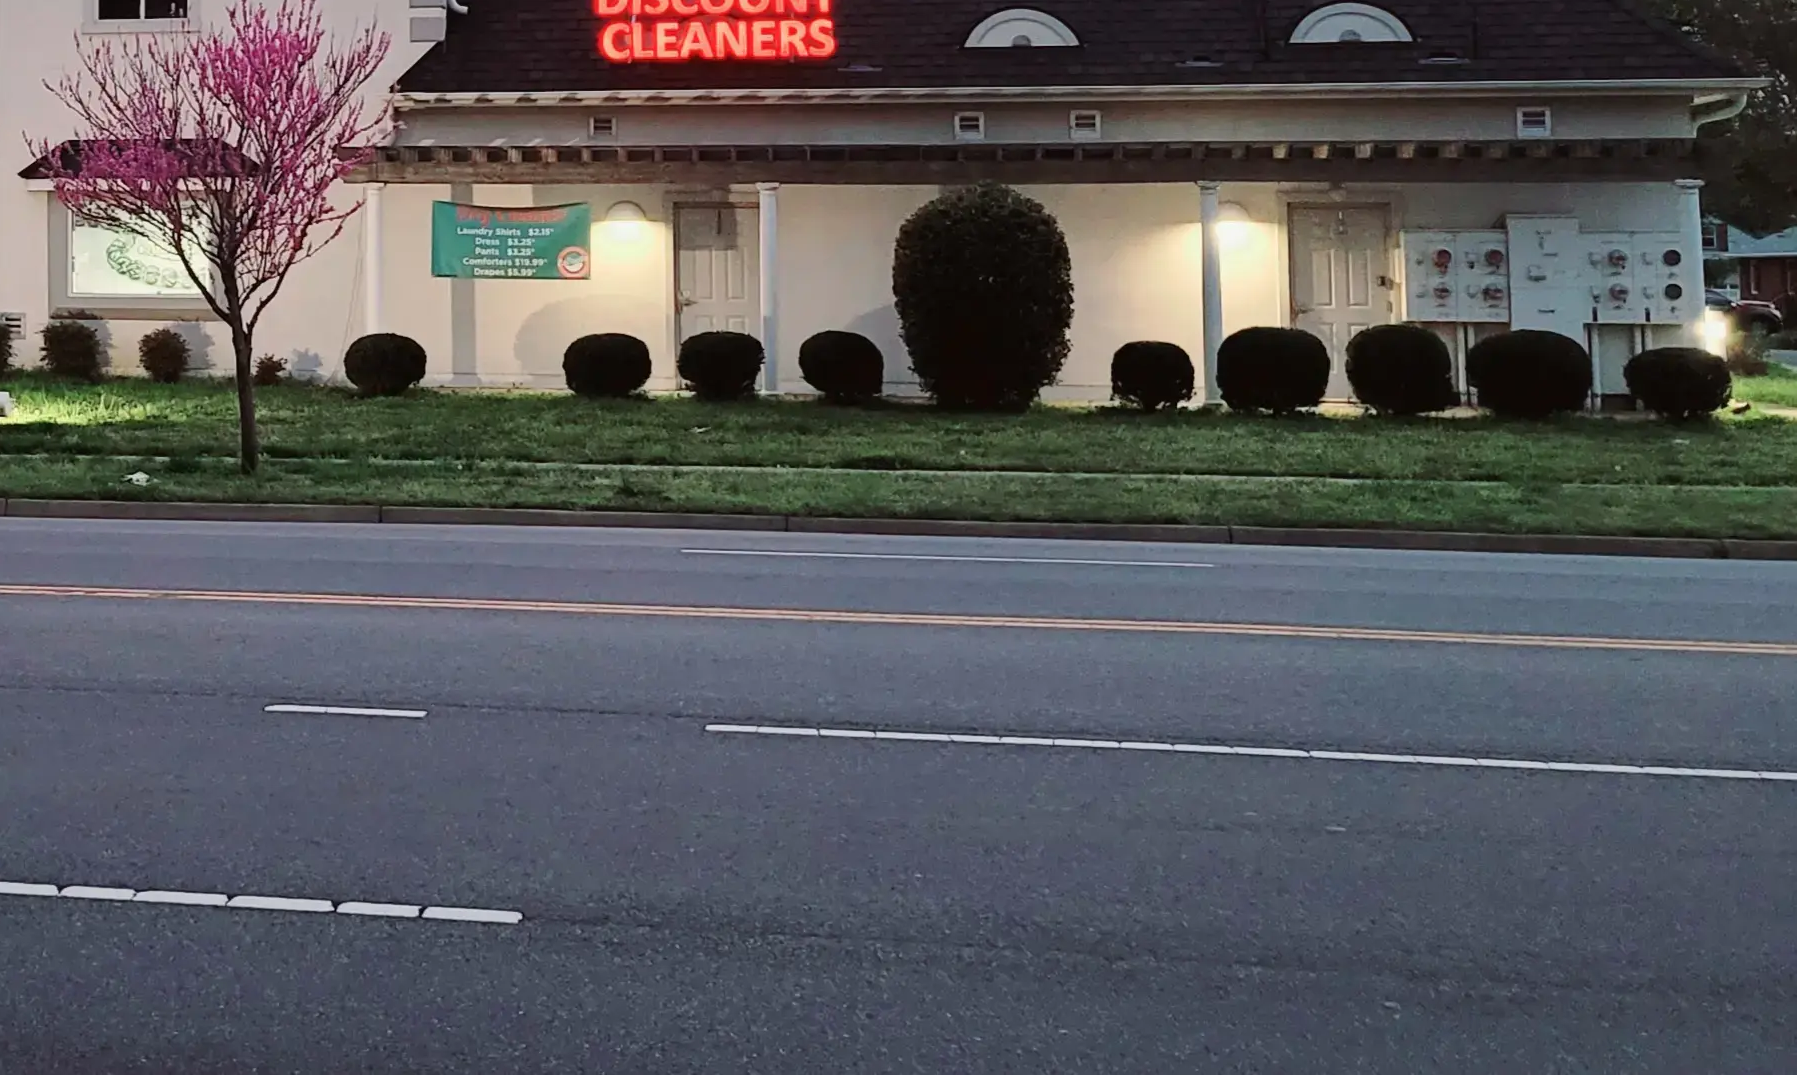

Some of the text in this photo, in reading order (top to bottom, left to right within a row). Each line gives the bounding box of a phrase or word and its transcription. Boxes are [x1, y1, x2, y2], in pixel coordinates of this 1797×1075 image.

[602, 19, 837, 60] CLEANERS
[457, 226, 493, 237] Laundry
[495, 227, 521, 237] Shirts
[475, 237, 500, 246] Dress
[475, 247, 500, 257] Pants
[462, 256, 513, 266] Comforters
[473, 267, 506, 277] Drapes
